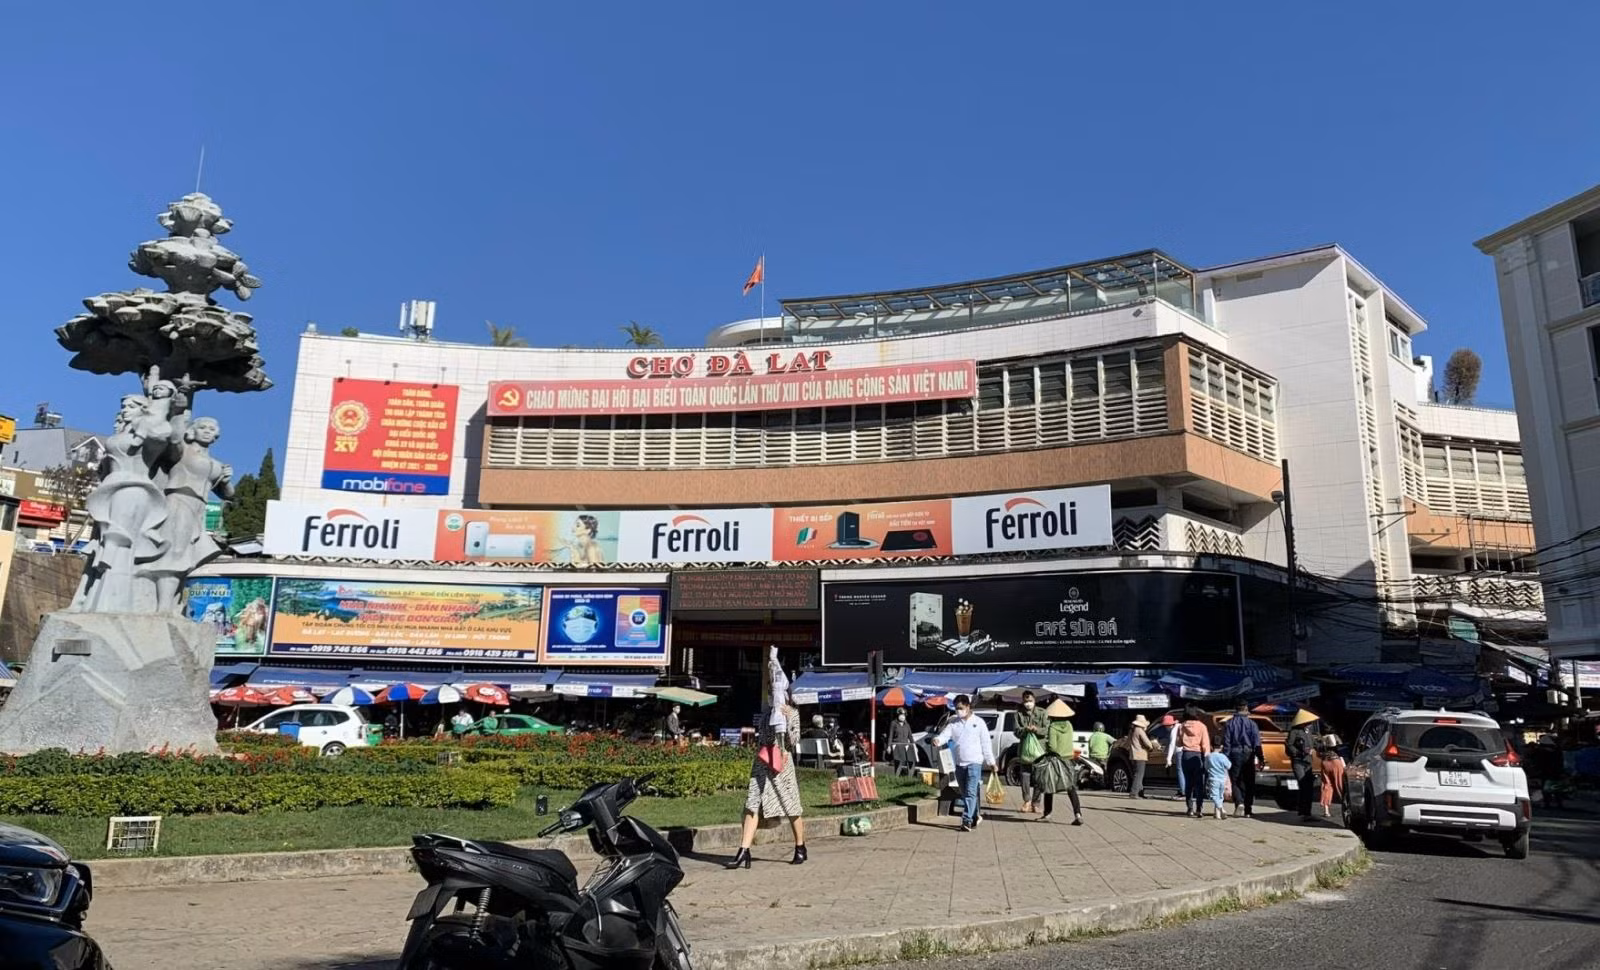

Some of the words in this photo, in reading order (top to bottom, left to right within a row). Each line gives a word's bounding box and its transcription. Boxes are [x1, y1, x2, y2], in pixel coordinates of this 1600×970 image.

[627, 353, 695, 379] CHỢ
[708, 350, 753, 374] ĐÀ
[526, 386, 554, 409] CHÀO
[557, 386, 589, 409] MỪNG
[592, 389, 608, 412] ĐẠI
[612, 385, 630, 412] HỘI
[632, 388, 650, 412] ĐẠI
[654, 382, 676, 408] BIỂU
[680, 383, 706, 407] TOÀN
[710, 380, 737, 406] QUỐC
[739, 378, 758, 404] LẦN
[761, 379, 781, 403] THỨ
[782, 382, 800, 402] XIII
[802, 375, 822, 401] CỦA
[824, 374, 853, 400] ĐẢNG
[856, 374, 884, 401] CỘNG
[888, 369, 910, 395] SẢN
[913, 369, 936, 397] VIỆT
[938, 370, 968, 392] NAM!
[342, 476, 426, 493] mobifone
[1060, 602, 1089, 614] Legend
[1035, 618, 1067, 636] CAFÉ
[1070, 618, 1095, 636] SỮA
[1098, 617, 1118, 636] ĐÁ
